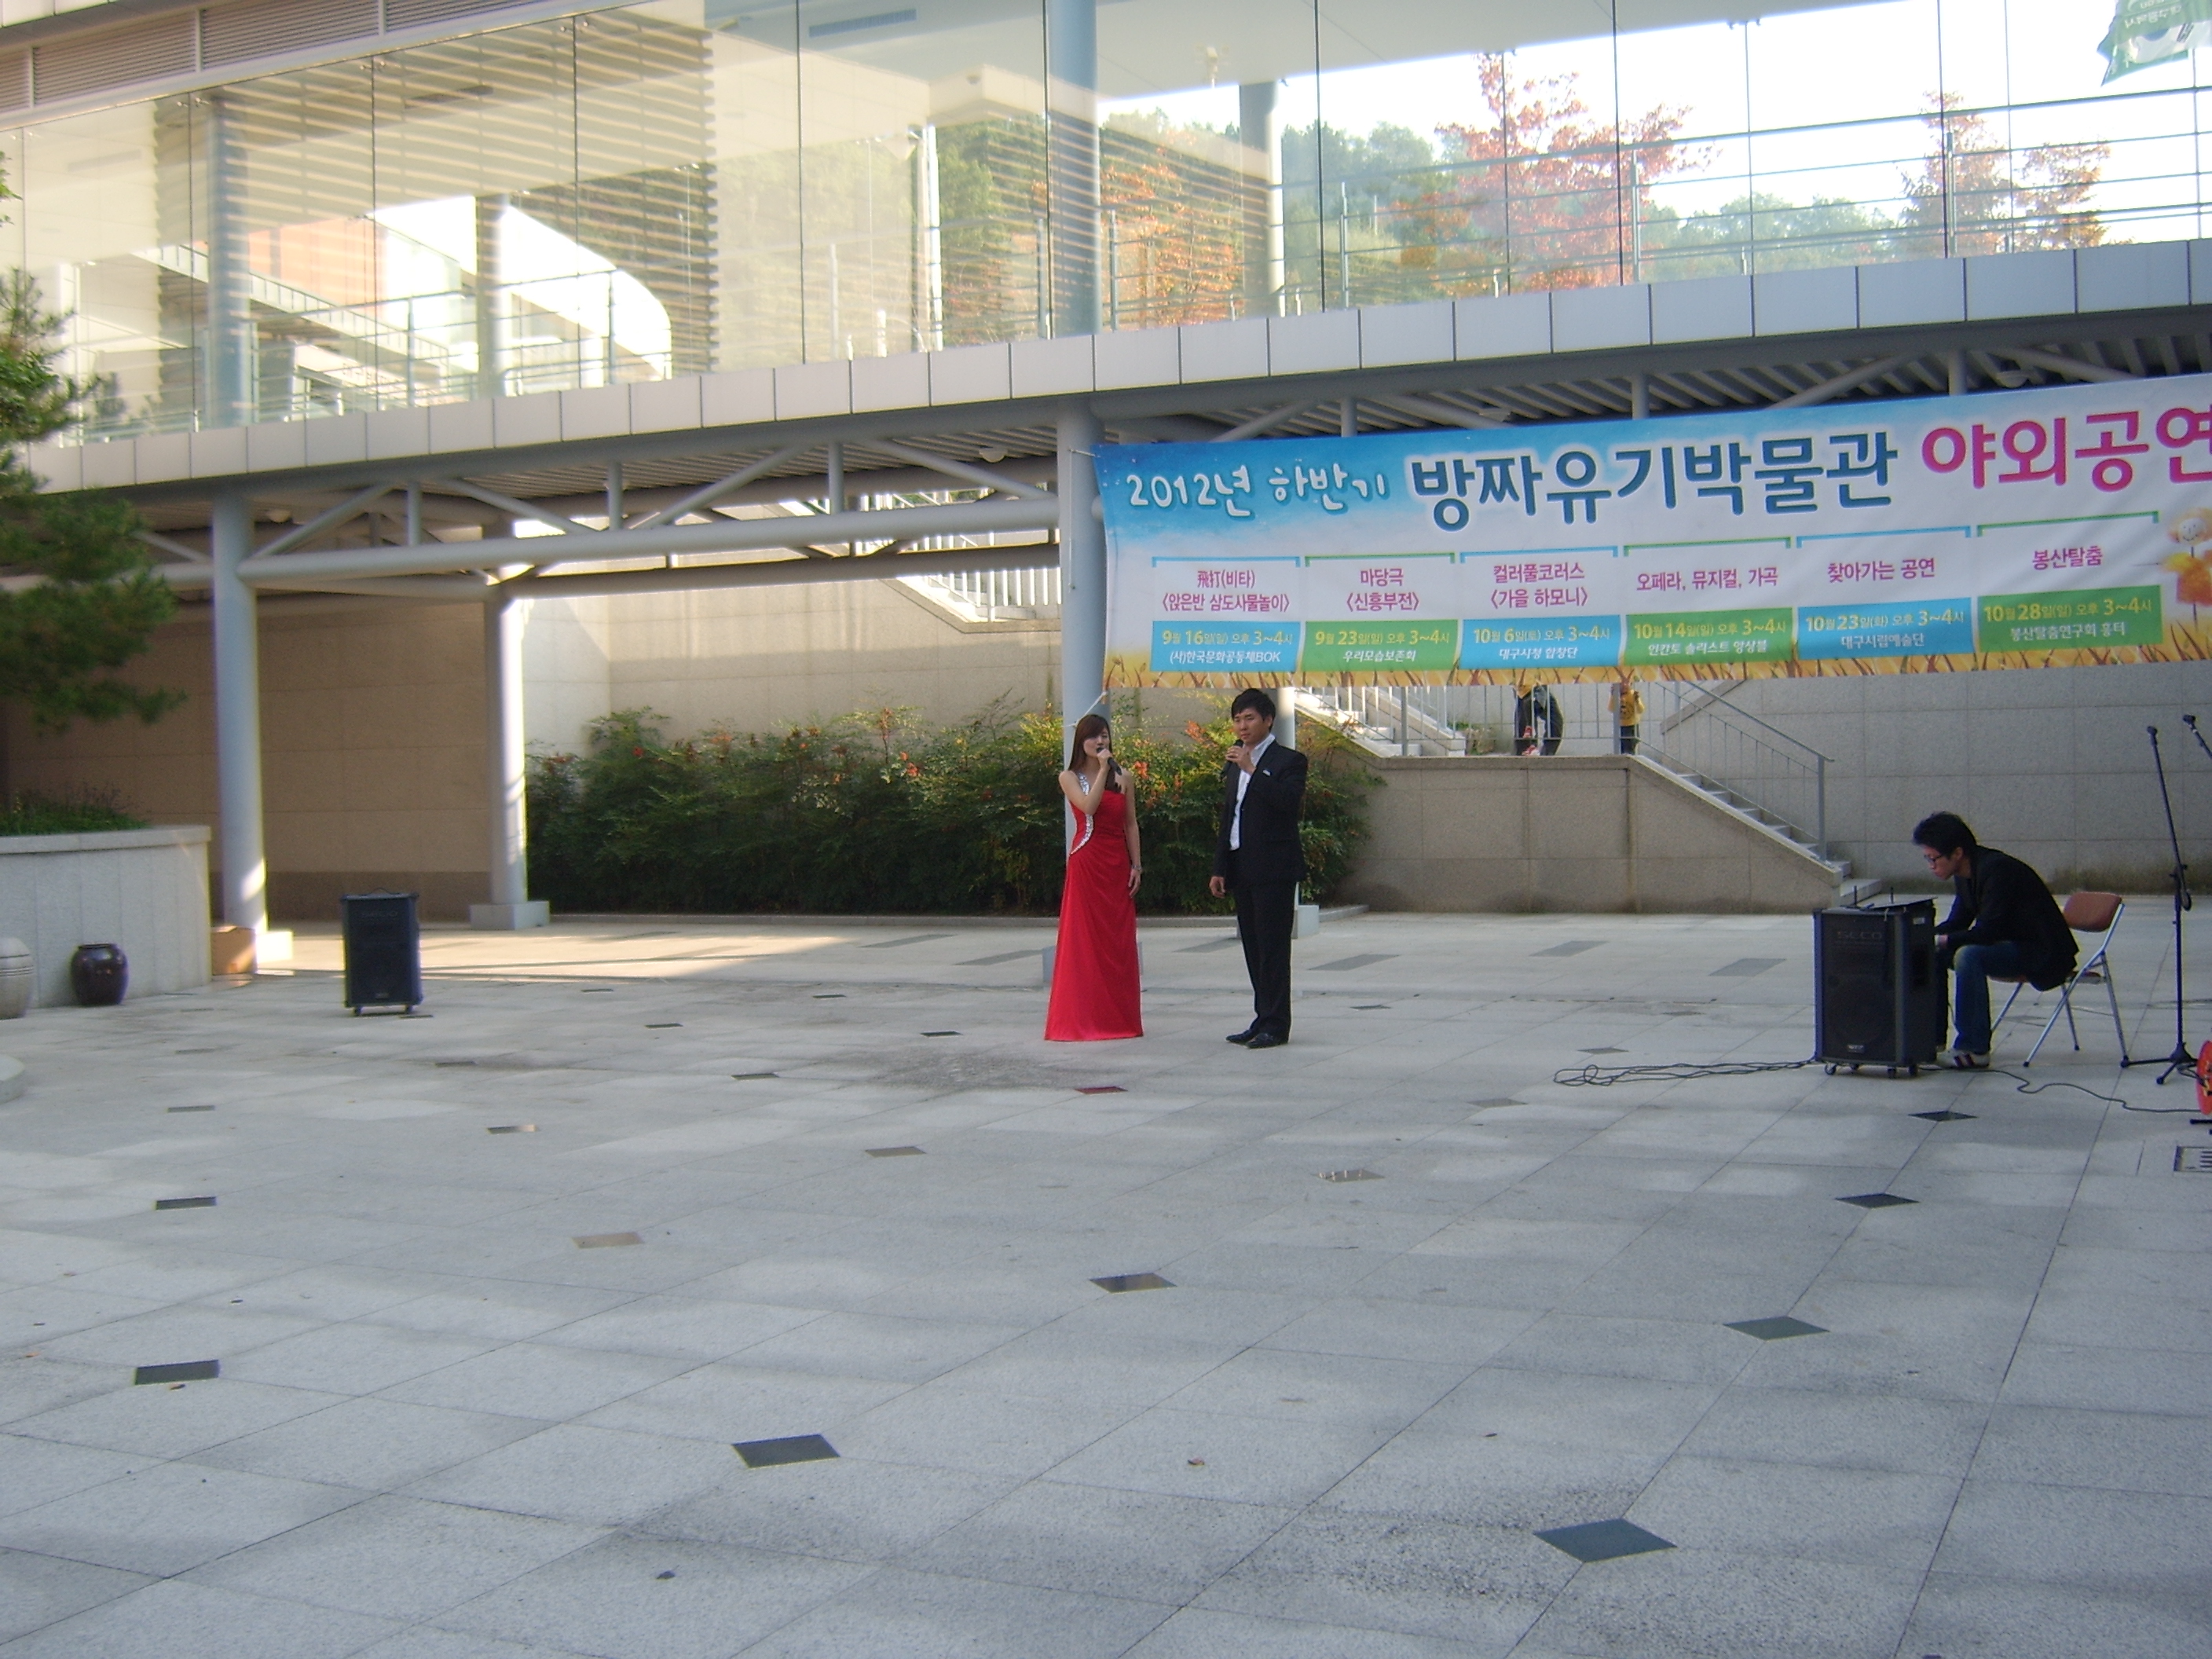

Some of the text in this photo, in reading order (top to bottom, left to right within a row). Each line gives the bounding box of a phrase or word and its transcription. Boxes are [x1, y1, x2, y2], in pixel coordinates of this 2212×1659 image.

[1126, 464, 1254, 517] 2012년
[1266, 462, 1389, 514] 하반기
[1411, 430, 1899, 533] 방짜유기박물관
[2032, 545, 2103, 570] 봉산탈춤
[1197, 569, 1256, 588] 飛打(비타)
[1360, 568, 1404, 588] 마당극
[1493, 562, 1585, 584] 컬러풀코러스
[1636, 566, 1778, 591] 오페라, 뮤지컬, 가곡
[1827, 558, 1936, 584] 찾아가는 공연
[2104, 598, 2152, 616] 3~4시
[1918, 609, 1964, 626] 3~4시
[1386, 632, 1405, 644] 오후
[1408, 630, 1449, 645] 3~4시
[1544, 629, 1564, 641] 오후
[1569, 626, 1610, 642] 3~4시
[1343, 650, 1416, 662] 우리모습보존회
